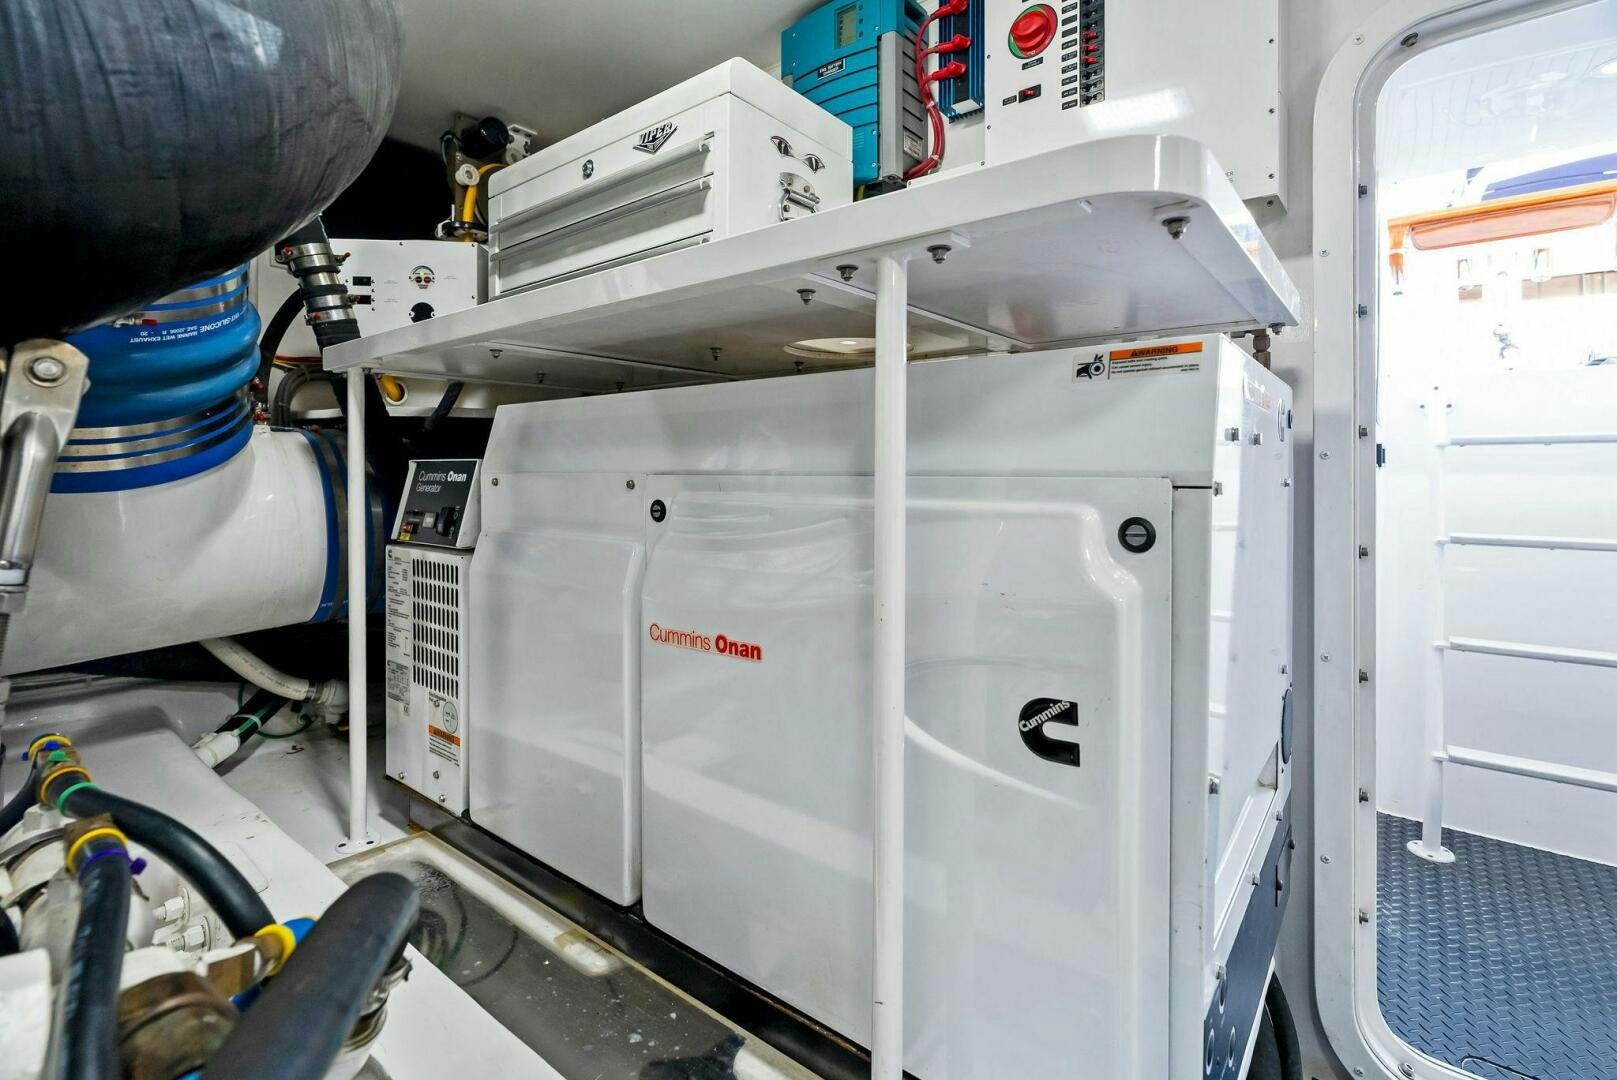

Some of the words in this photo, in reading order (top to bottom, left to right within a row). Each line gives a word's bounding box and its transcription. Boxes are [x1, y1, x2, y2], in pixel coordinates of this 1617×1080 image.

[640, 121, 672, 144] VIPER
[130, 335, 161, 343] EXHAUST
[177, 331, 198, 339] MARINE
[1139, 345, 1178, 356] WARNING
[418, 470, 446, 481] Cummins
[447, 470, 467, 482] Onan
[415, 483, 441, 493] Generator
[649, 623, 711, 651] Cummins
[714, 634, 762, 660] Onan
[1020, 700, 1071, 732] Cummins
